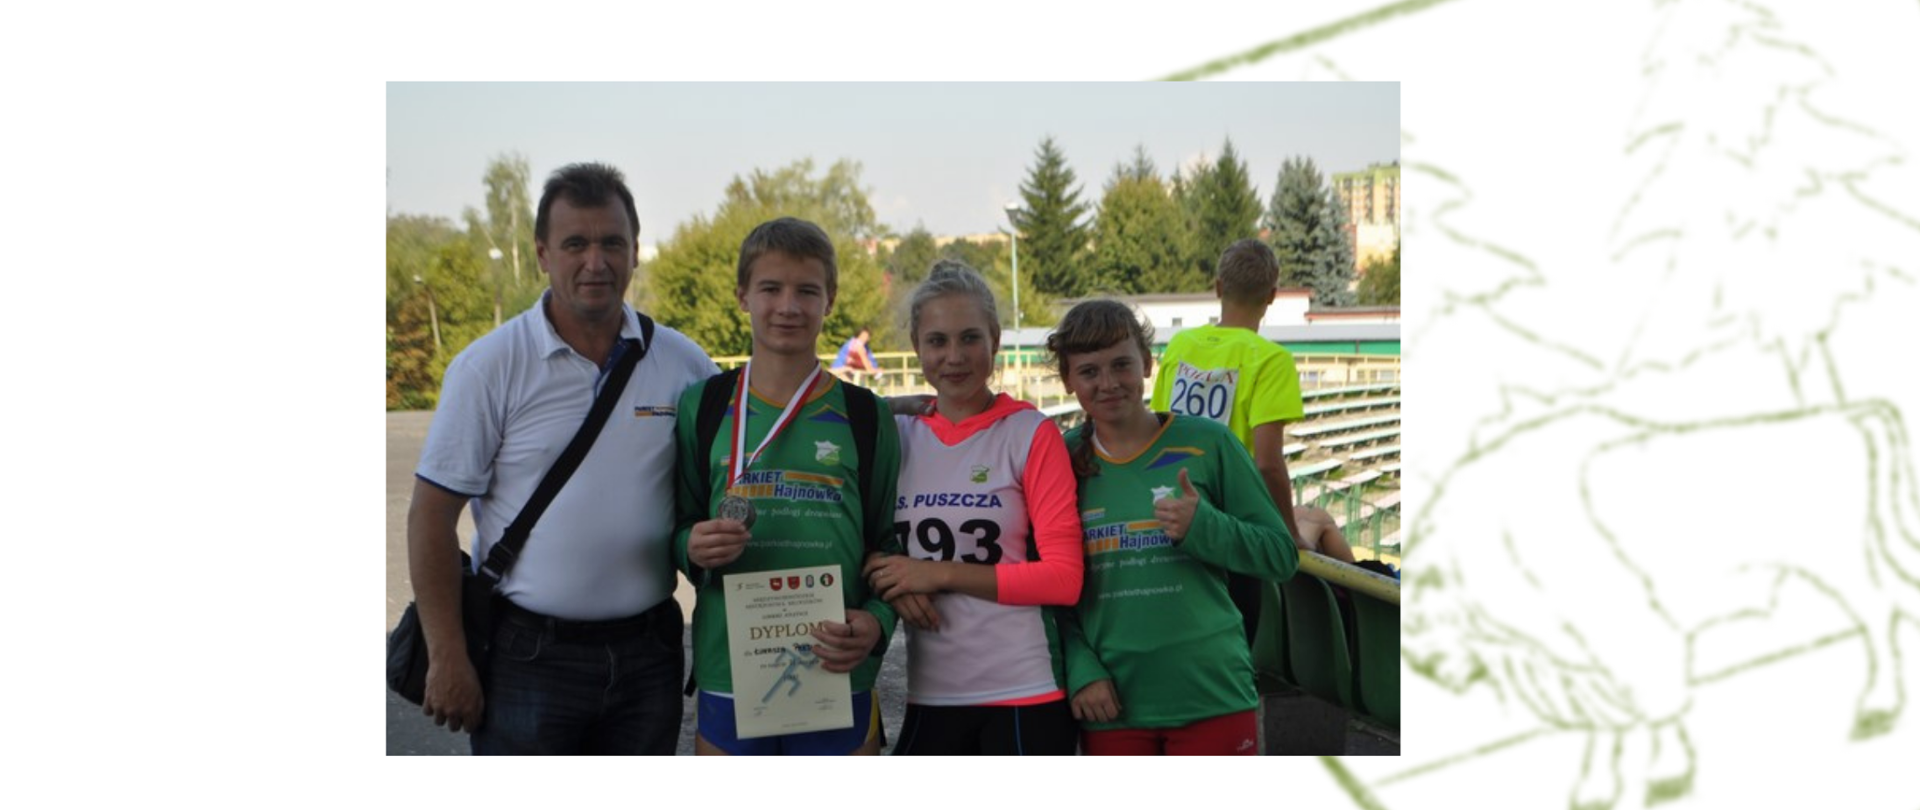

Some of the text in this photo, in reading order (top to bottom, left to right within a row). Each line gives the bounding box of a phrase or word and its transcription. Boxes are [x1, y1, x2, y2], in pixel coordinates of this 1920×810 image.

[1170, 378, 1228, 419] 260
[774, 483, 842, 502] Hajnówka
[913, 493, 1003, 508] PUSZCZA
[1083, 522, 1126, 541] ARKIET
[1120, 533, 1173, 551] Hajnów
